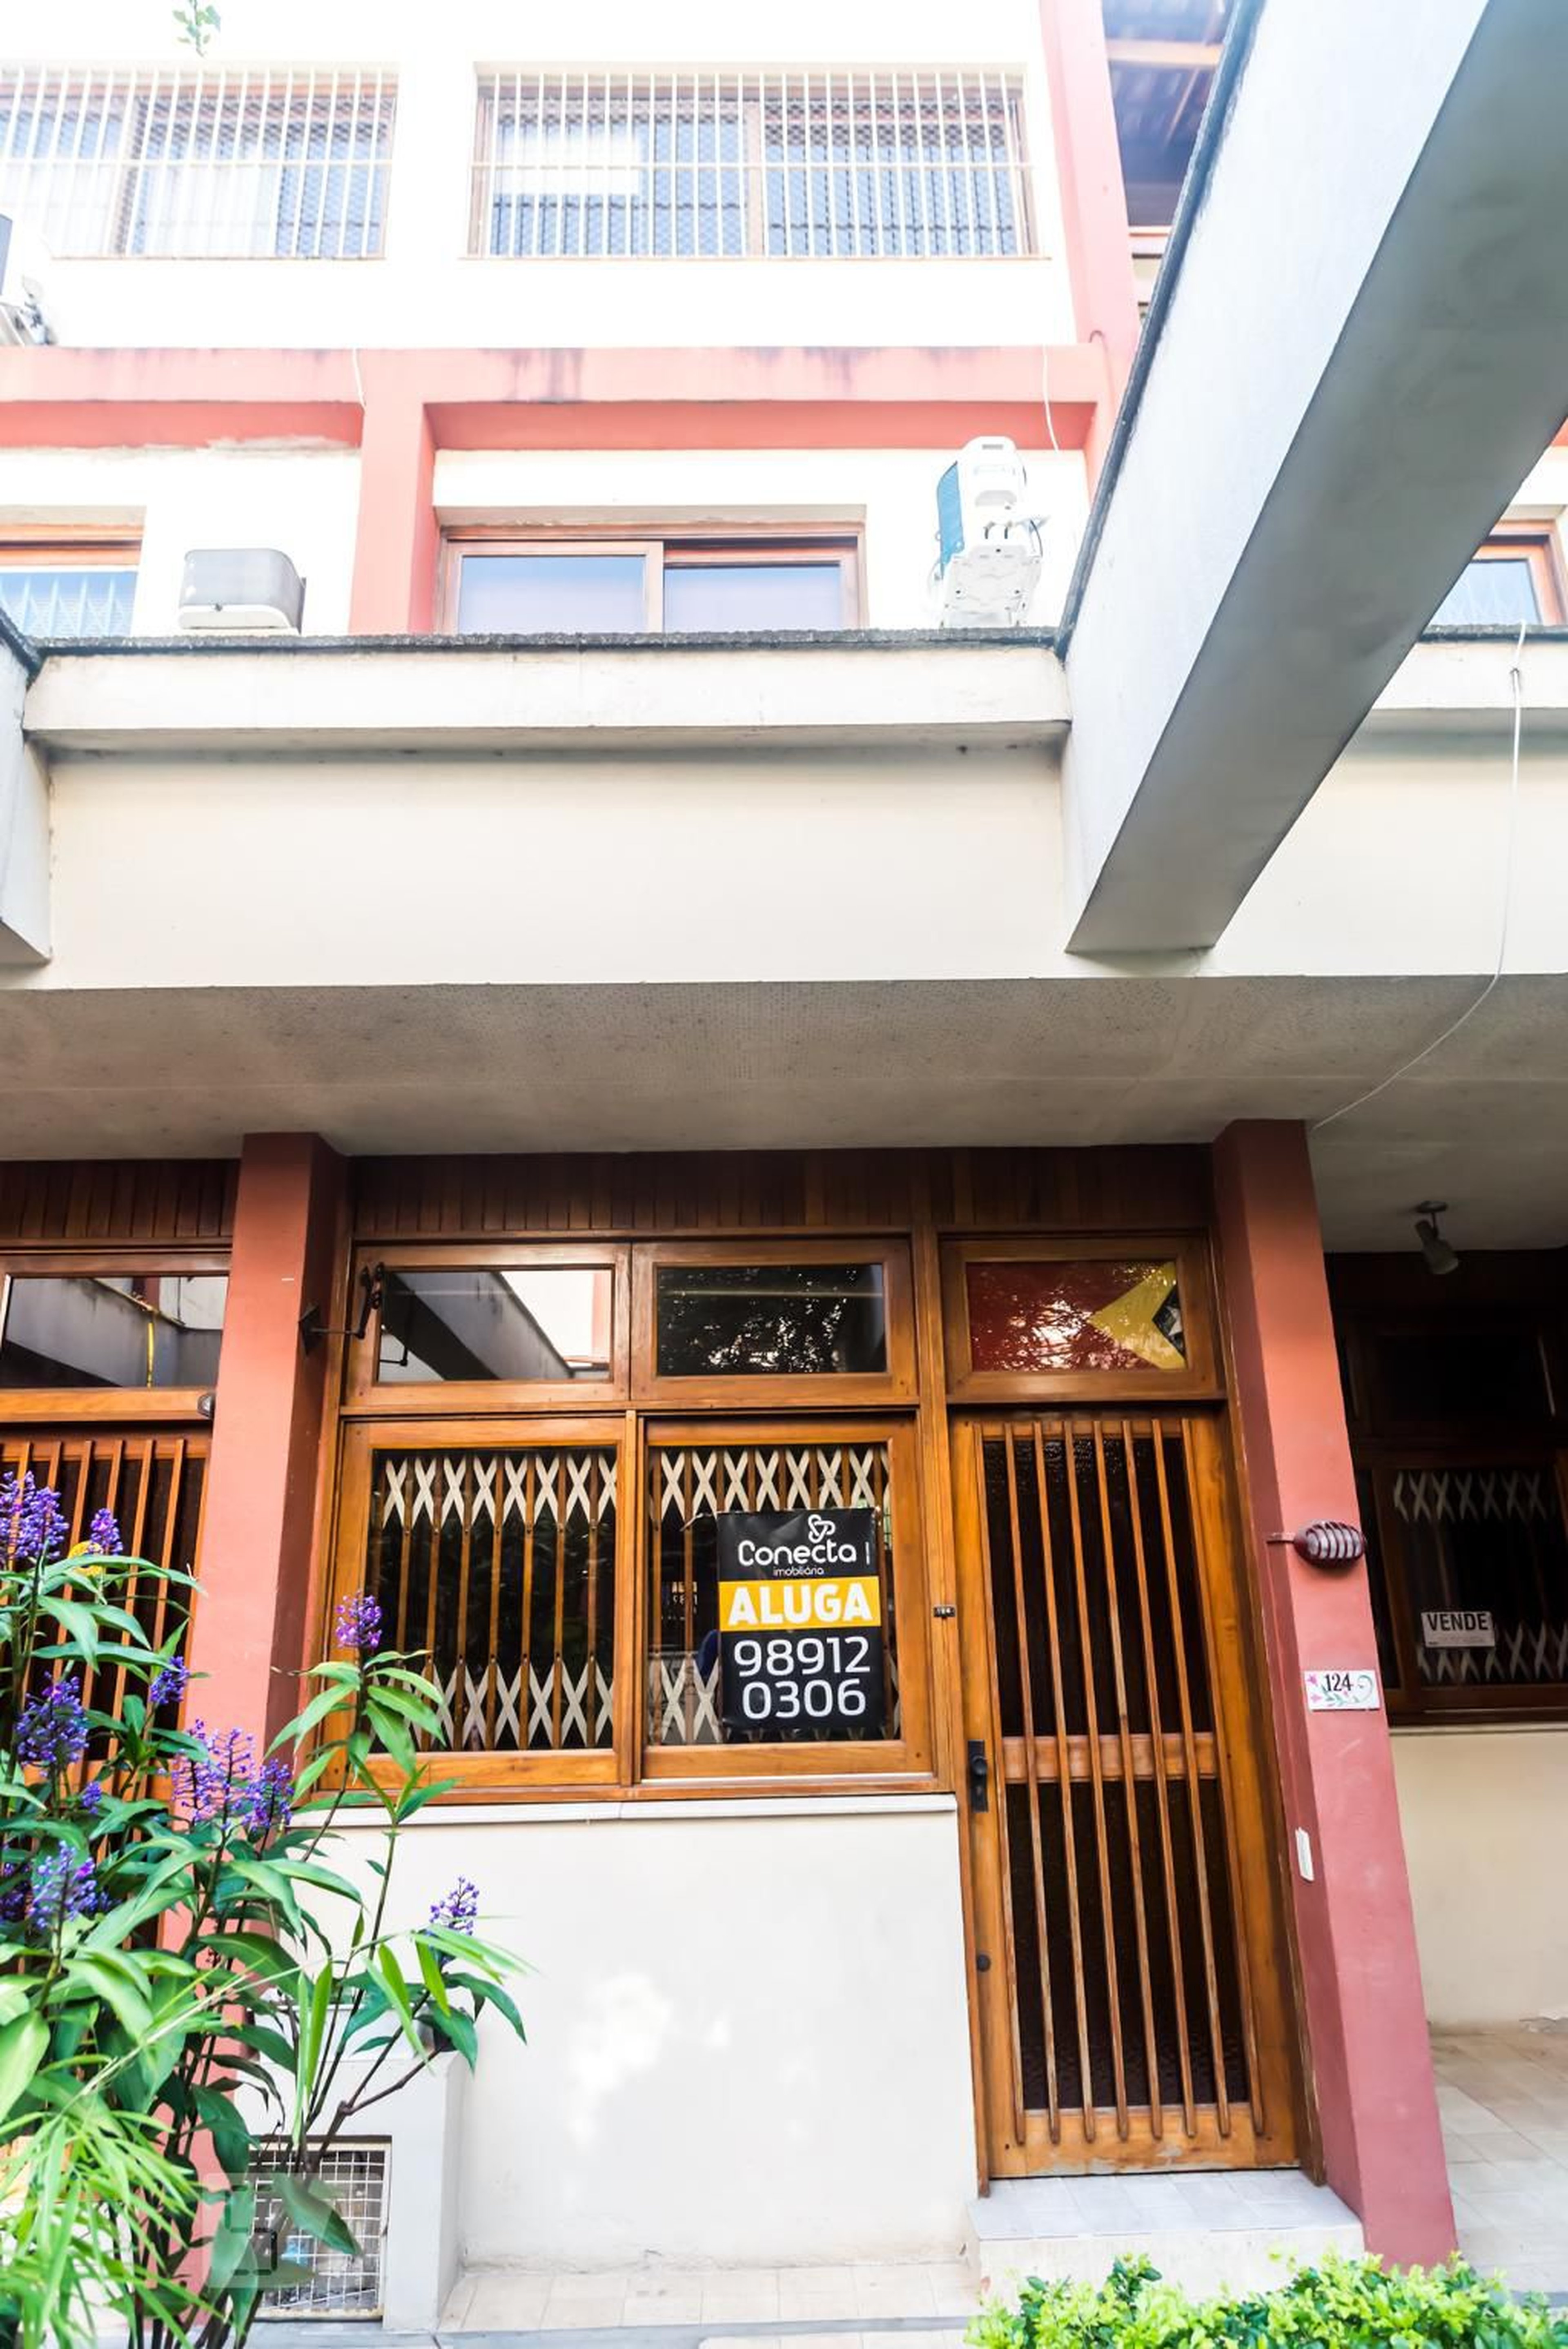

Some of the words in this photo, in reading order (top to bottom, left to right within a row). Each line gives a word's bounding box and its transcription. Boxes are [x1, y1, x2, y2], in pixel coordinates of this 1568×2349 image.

[737, 1540, 857, 1566] Conecta
[728, 1583, 873, 1625] ALUGA
[1427, 1613, 1489, 1631] VENDE
[734, 1636, 870, 1677] 98912
[742, 1678, 866, 1719] 0306
[1324, 1672, 1354, 1692] 124
